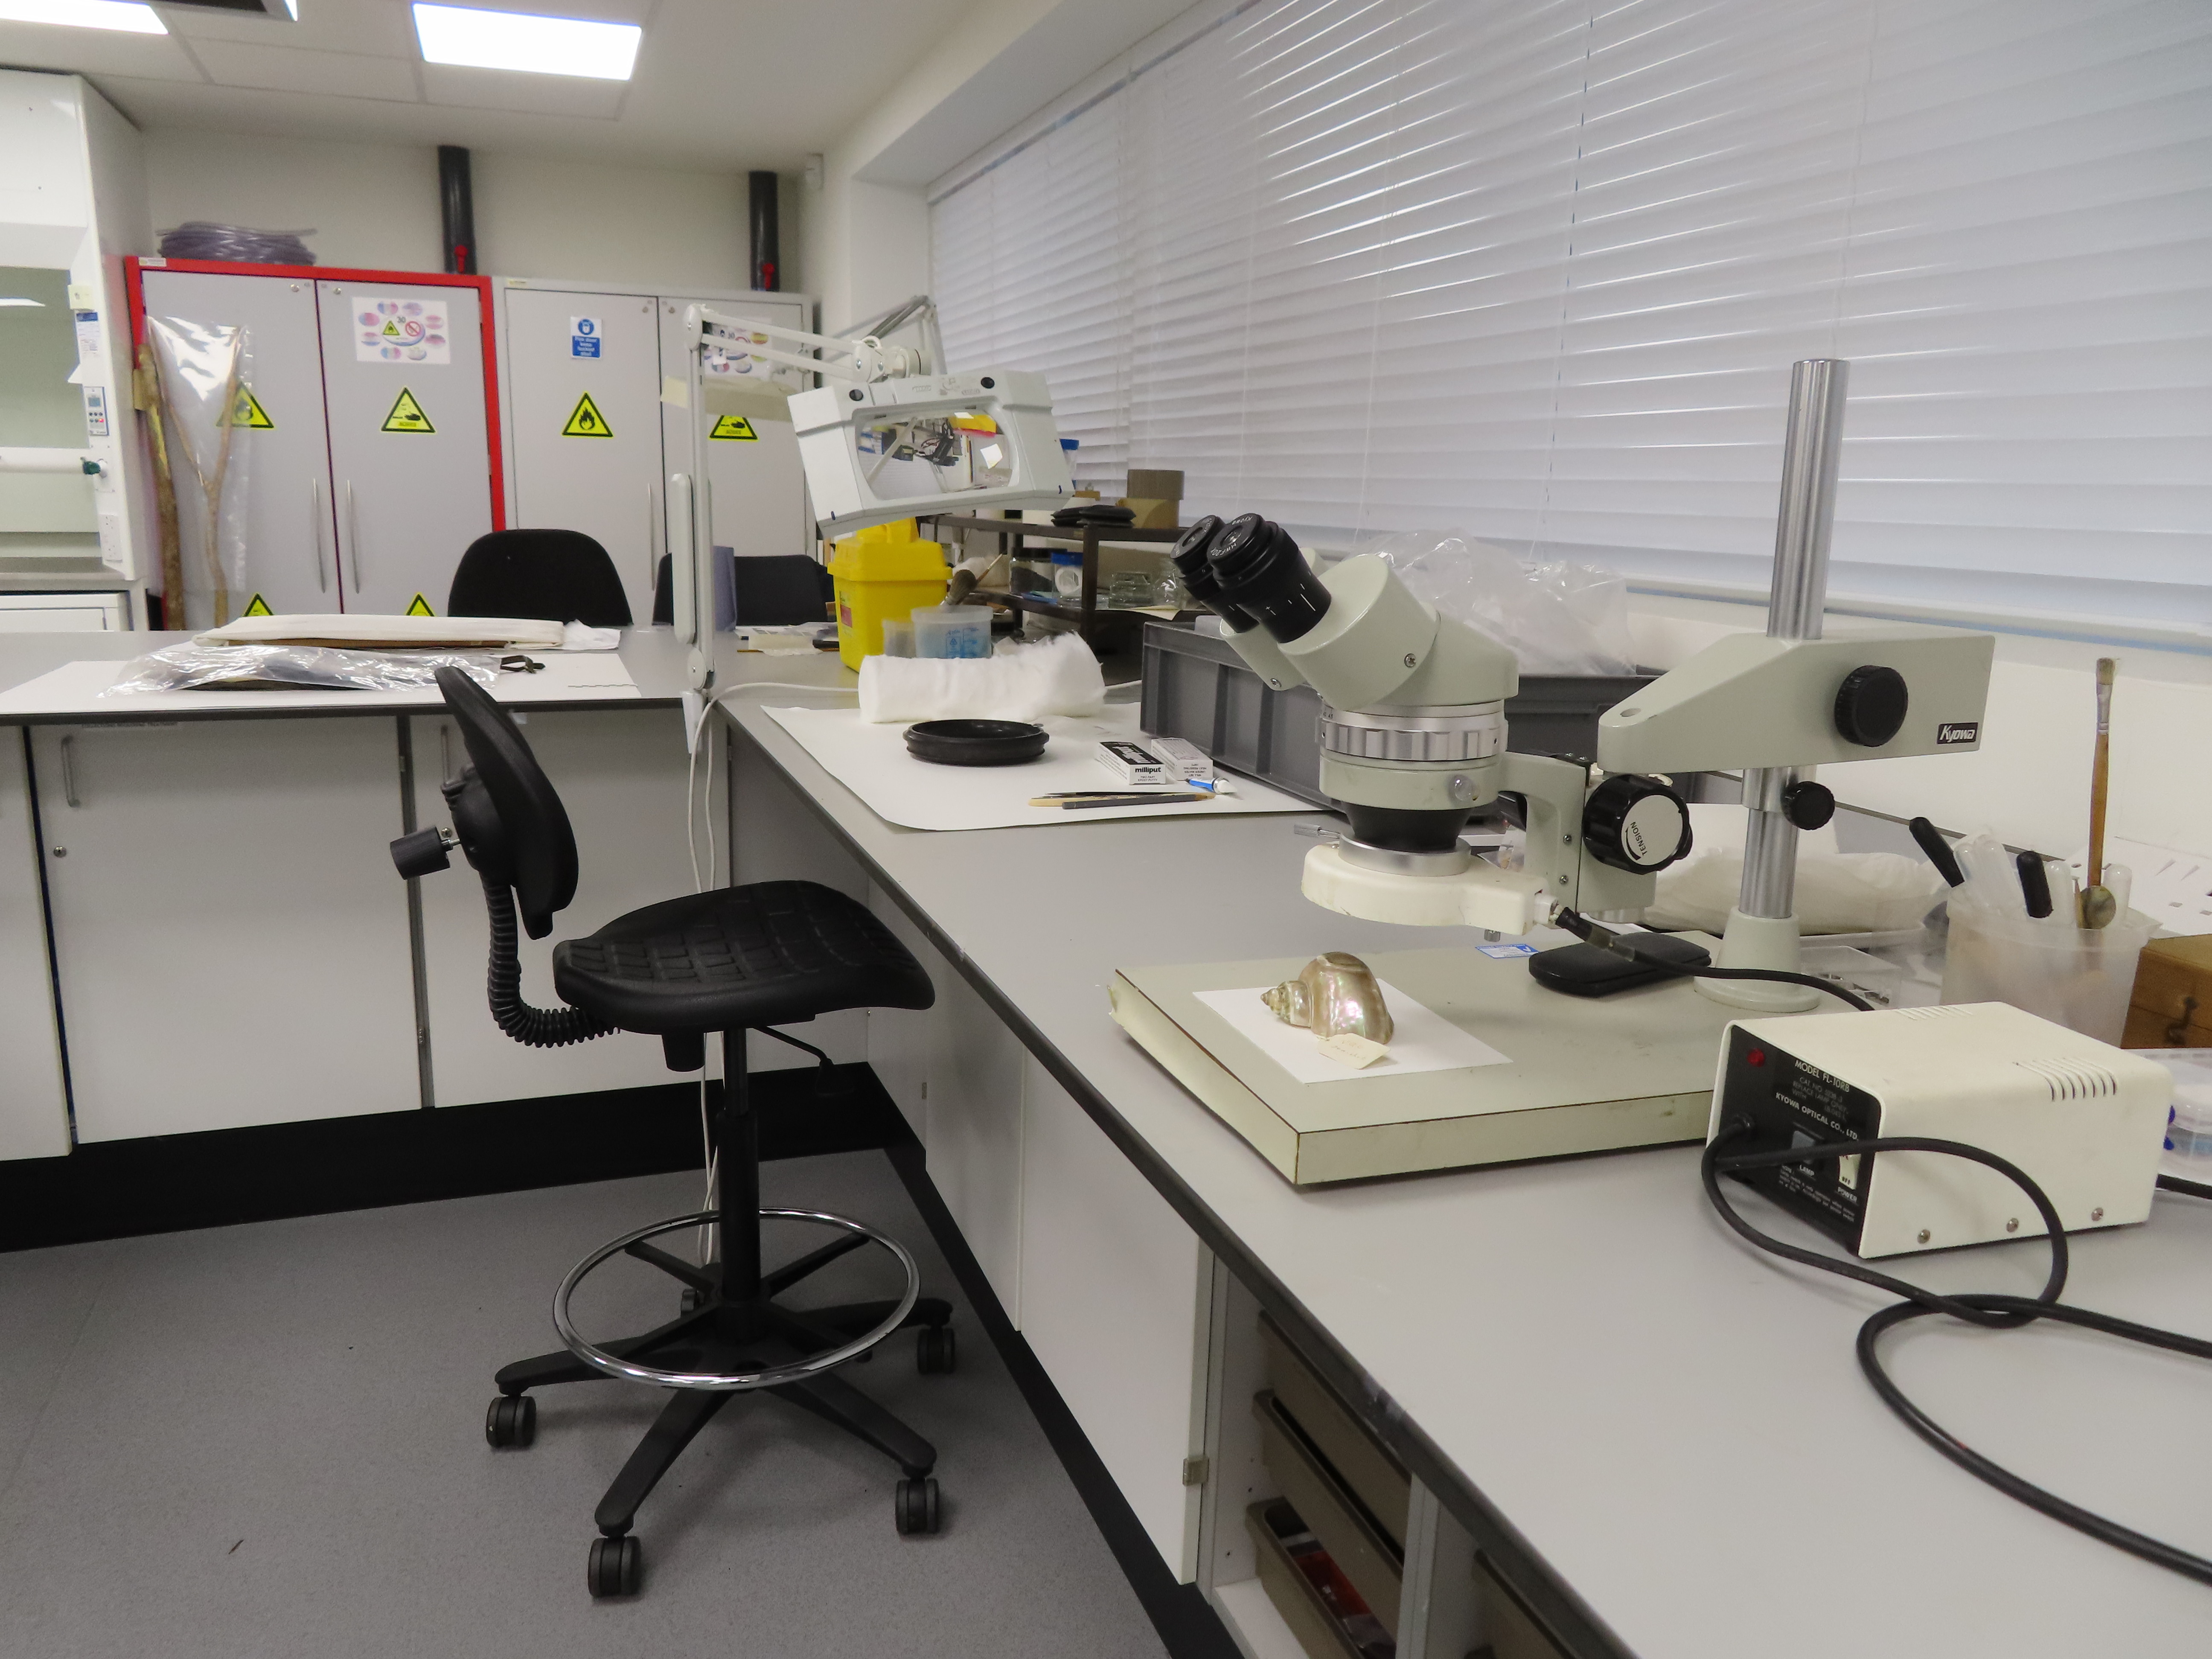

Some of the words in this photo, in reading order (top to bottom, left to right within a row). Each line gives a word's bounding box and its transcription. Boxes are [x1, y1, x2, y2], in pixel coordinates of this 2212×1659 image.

[1939, 725, 1976, 742] Kyowa
[1630, 822, 1647, 856] TENSION
[1795, 1060, 1819, 1078] MODEL
[1822, 1073, 1850, 1092] FL-10RB
[1775, 1092, 1799, 1109] KYOWA
[1802, 1106, 1828, 1125] OPTICAL
[1846, 1129, 1859, 1141] LTD.
[1799, 1164, 1814, 1176] LAMP
[1837, 1187, 1857, 1202] POWER
